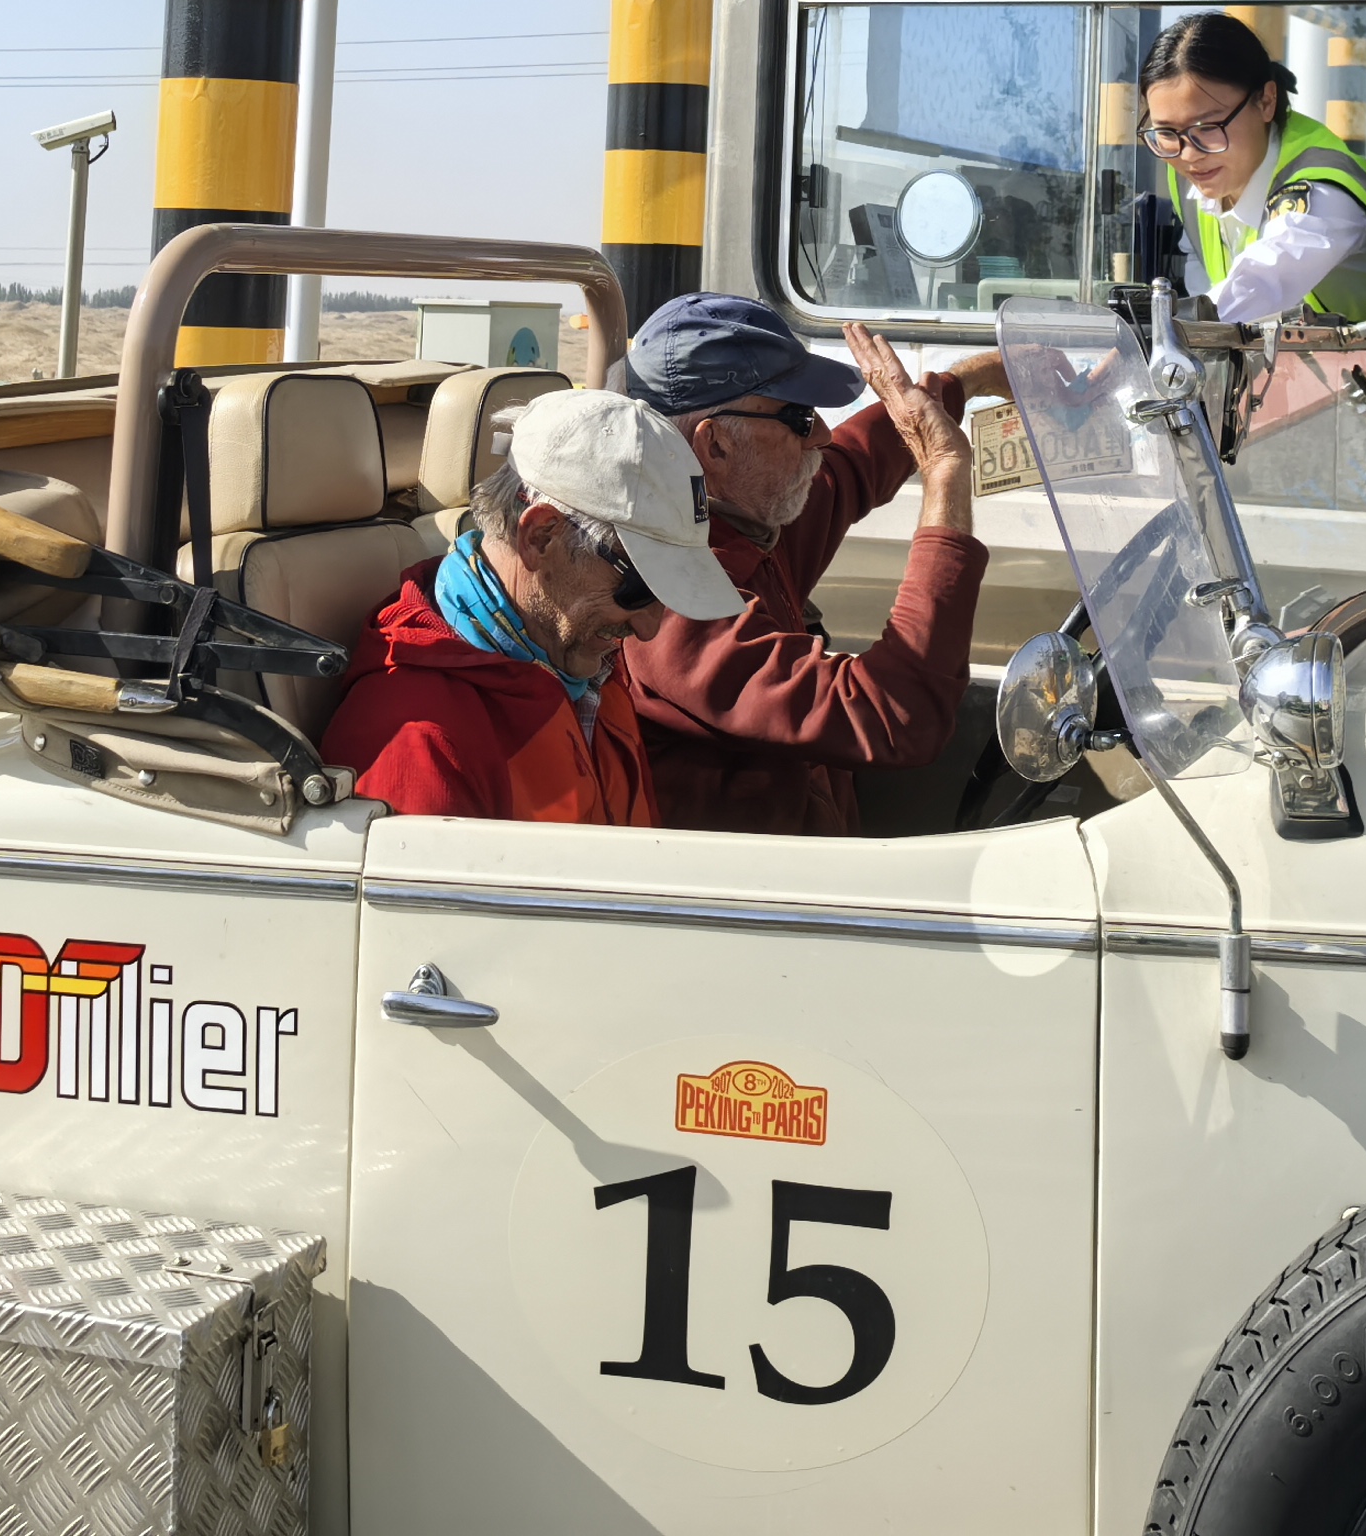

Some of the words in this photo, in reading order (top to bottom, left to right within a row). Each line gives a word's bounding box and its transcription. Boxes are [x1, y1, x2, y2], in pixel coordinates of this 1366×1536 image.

[680, 1080, 752, 1133] PEKING
[752, 1111, 761, 1126] TO
[762, 1095, 823, 1140] PARIS
[710, 1070, 732, 1095] 1907
[771, 1075, 795, 1100] 2024
[593, 1165, 896, 1405] 15
